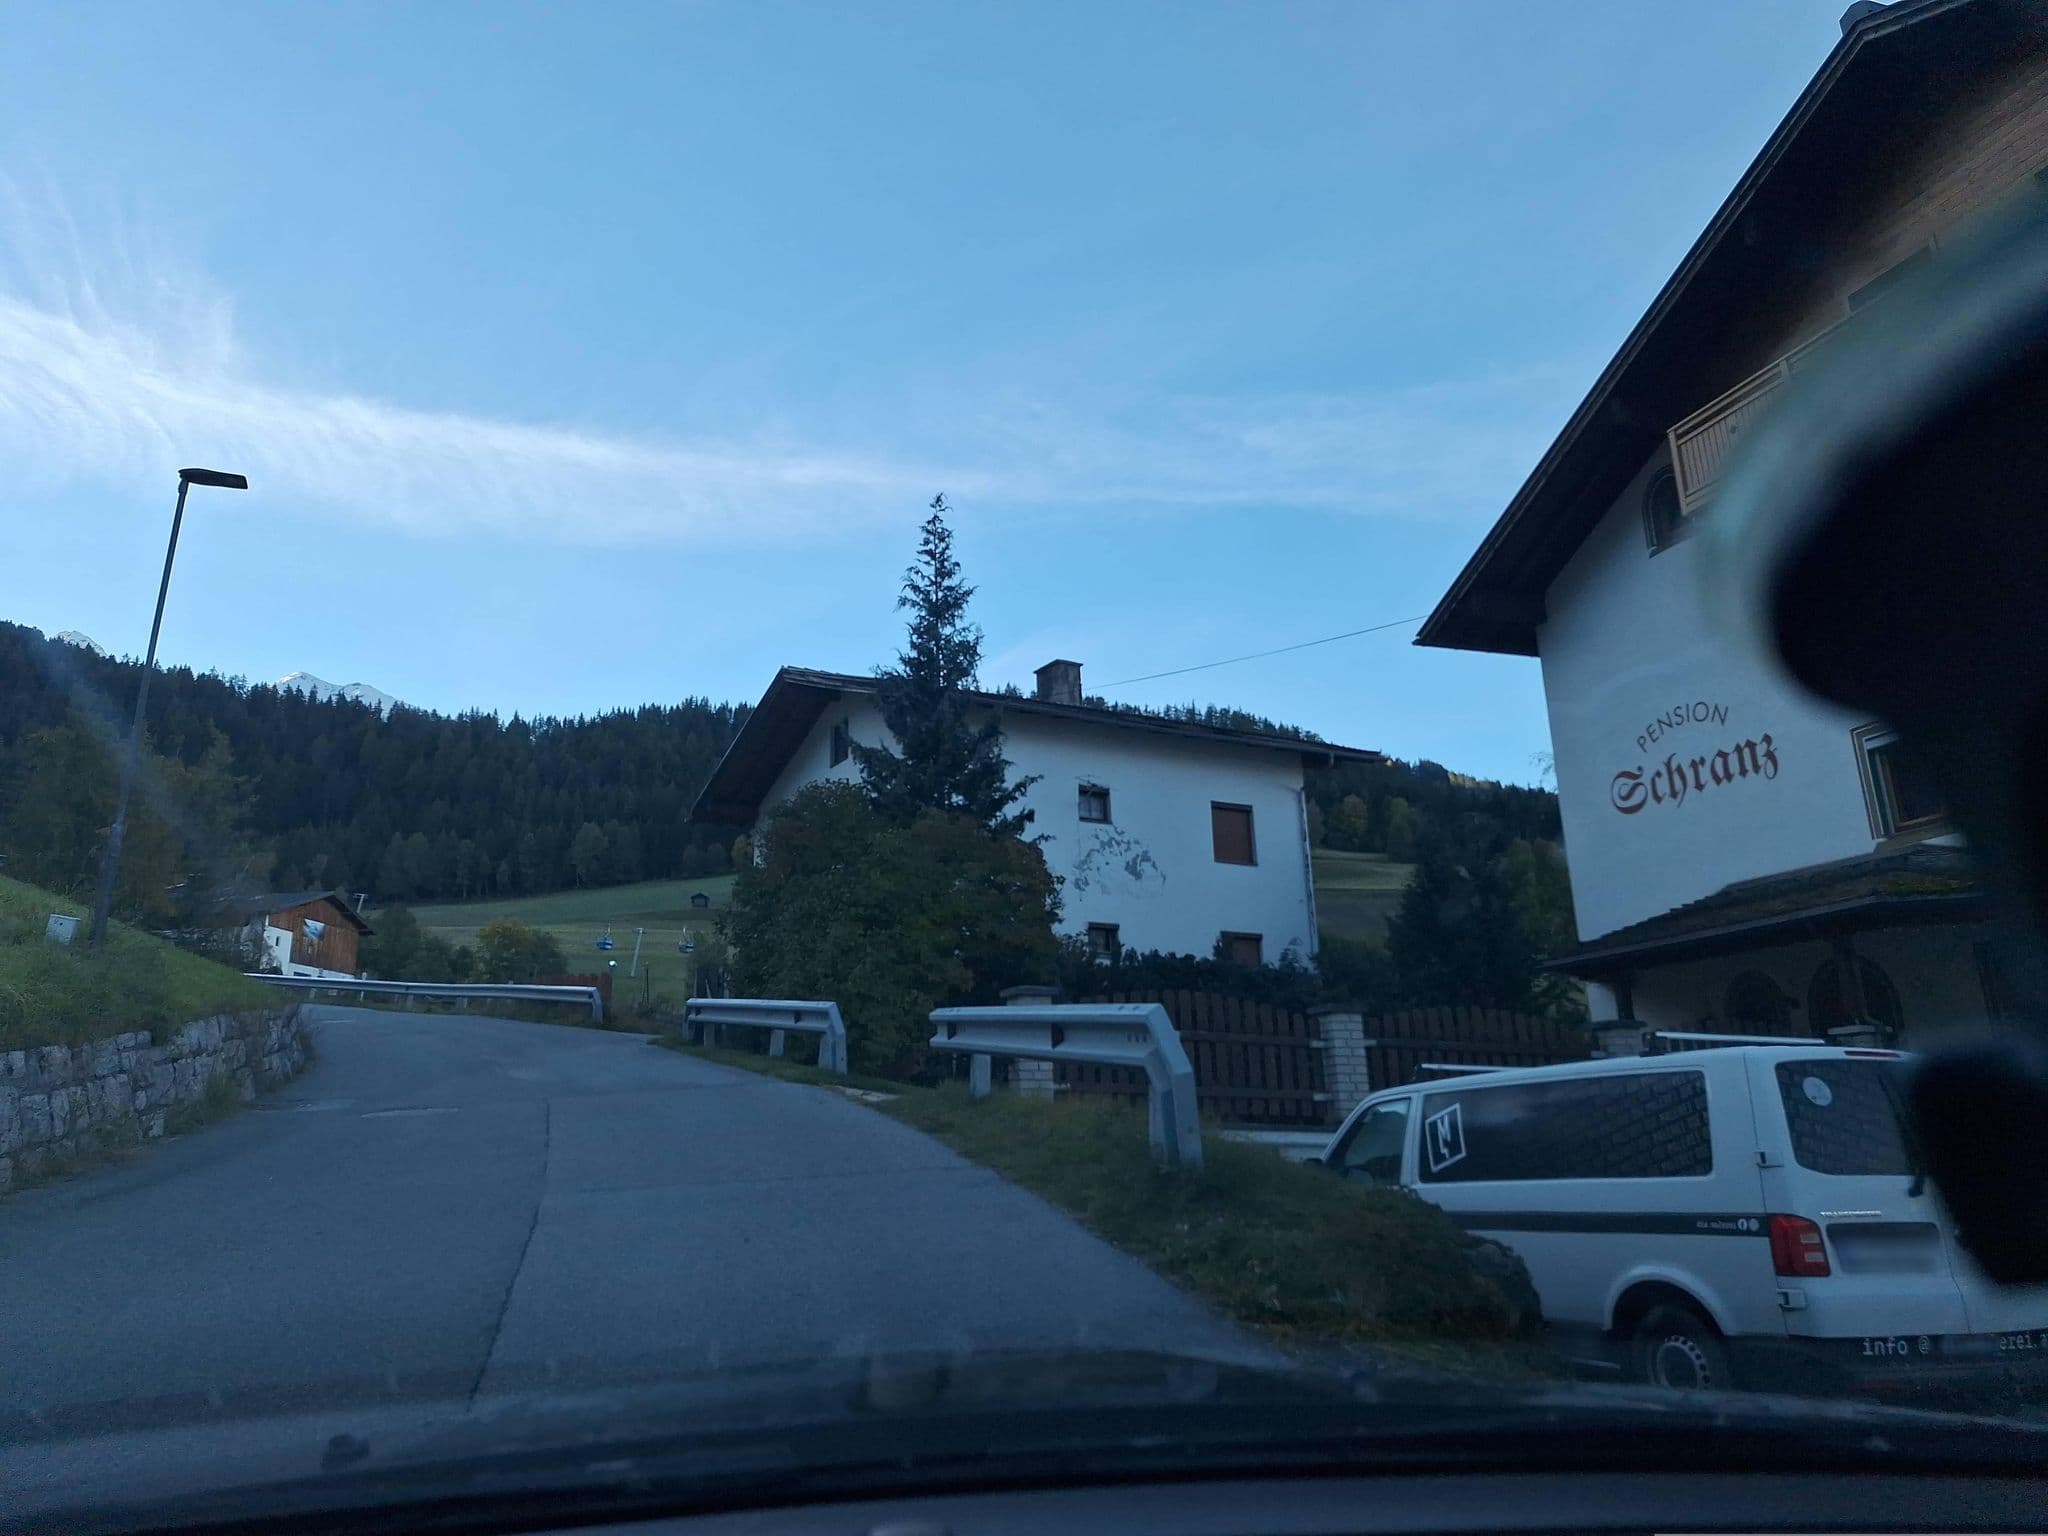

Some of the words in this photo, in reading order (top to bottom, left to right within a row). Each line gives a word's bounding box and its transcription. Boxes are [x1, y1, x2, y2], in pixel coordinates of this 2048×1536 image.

[1636, 701, 1729, 753] PENSION
[1611, 732, 1779, 815] Schranz
[1862, 1336, 1909, 1356] info
